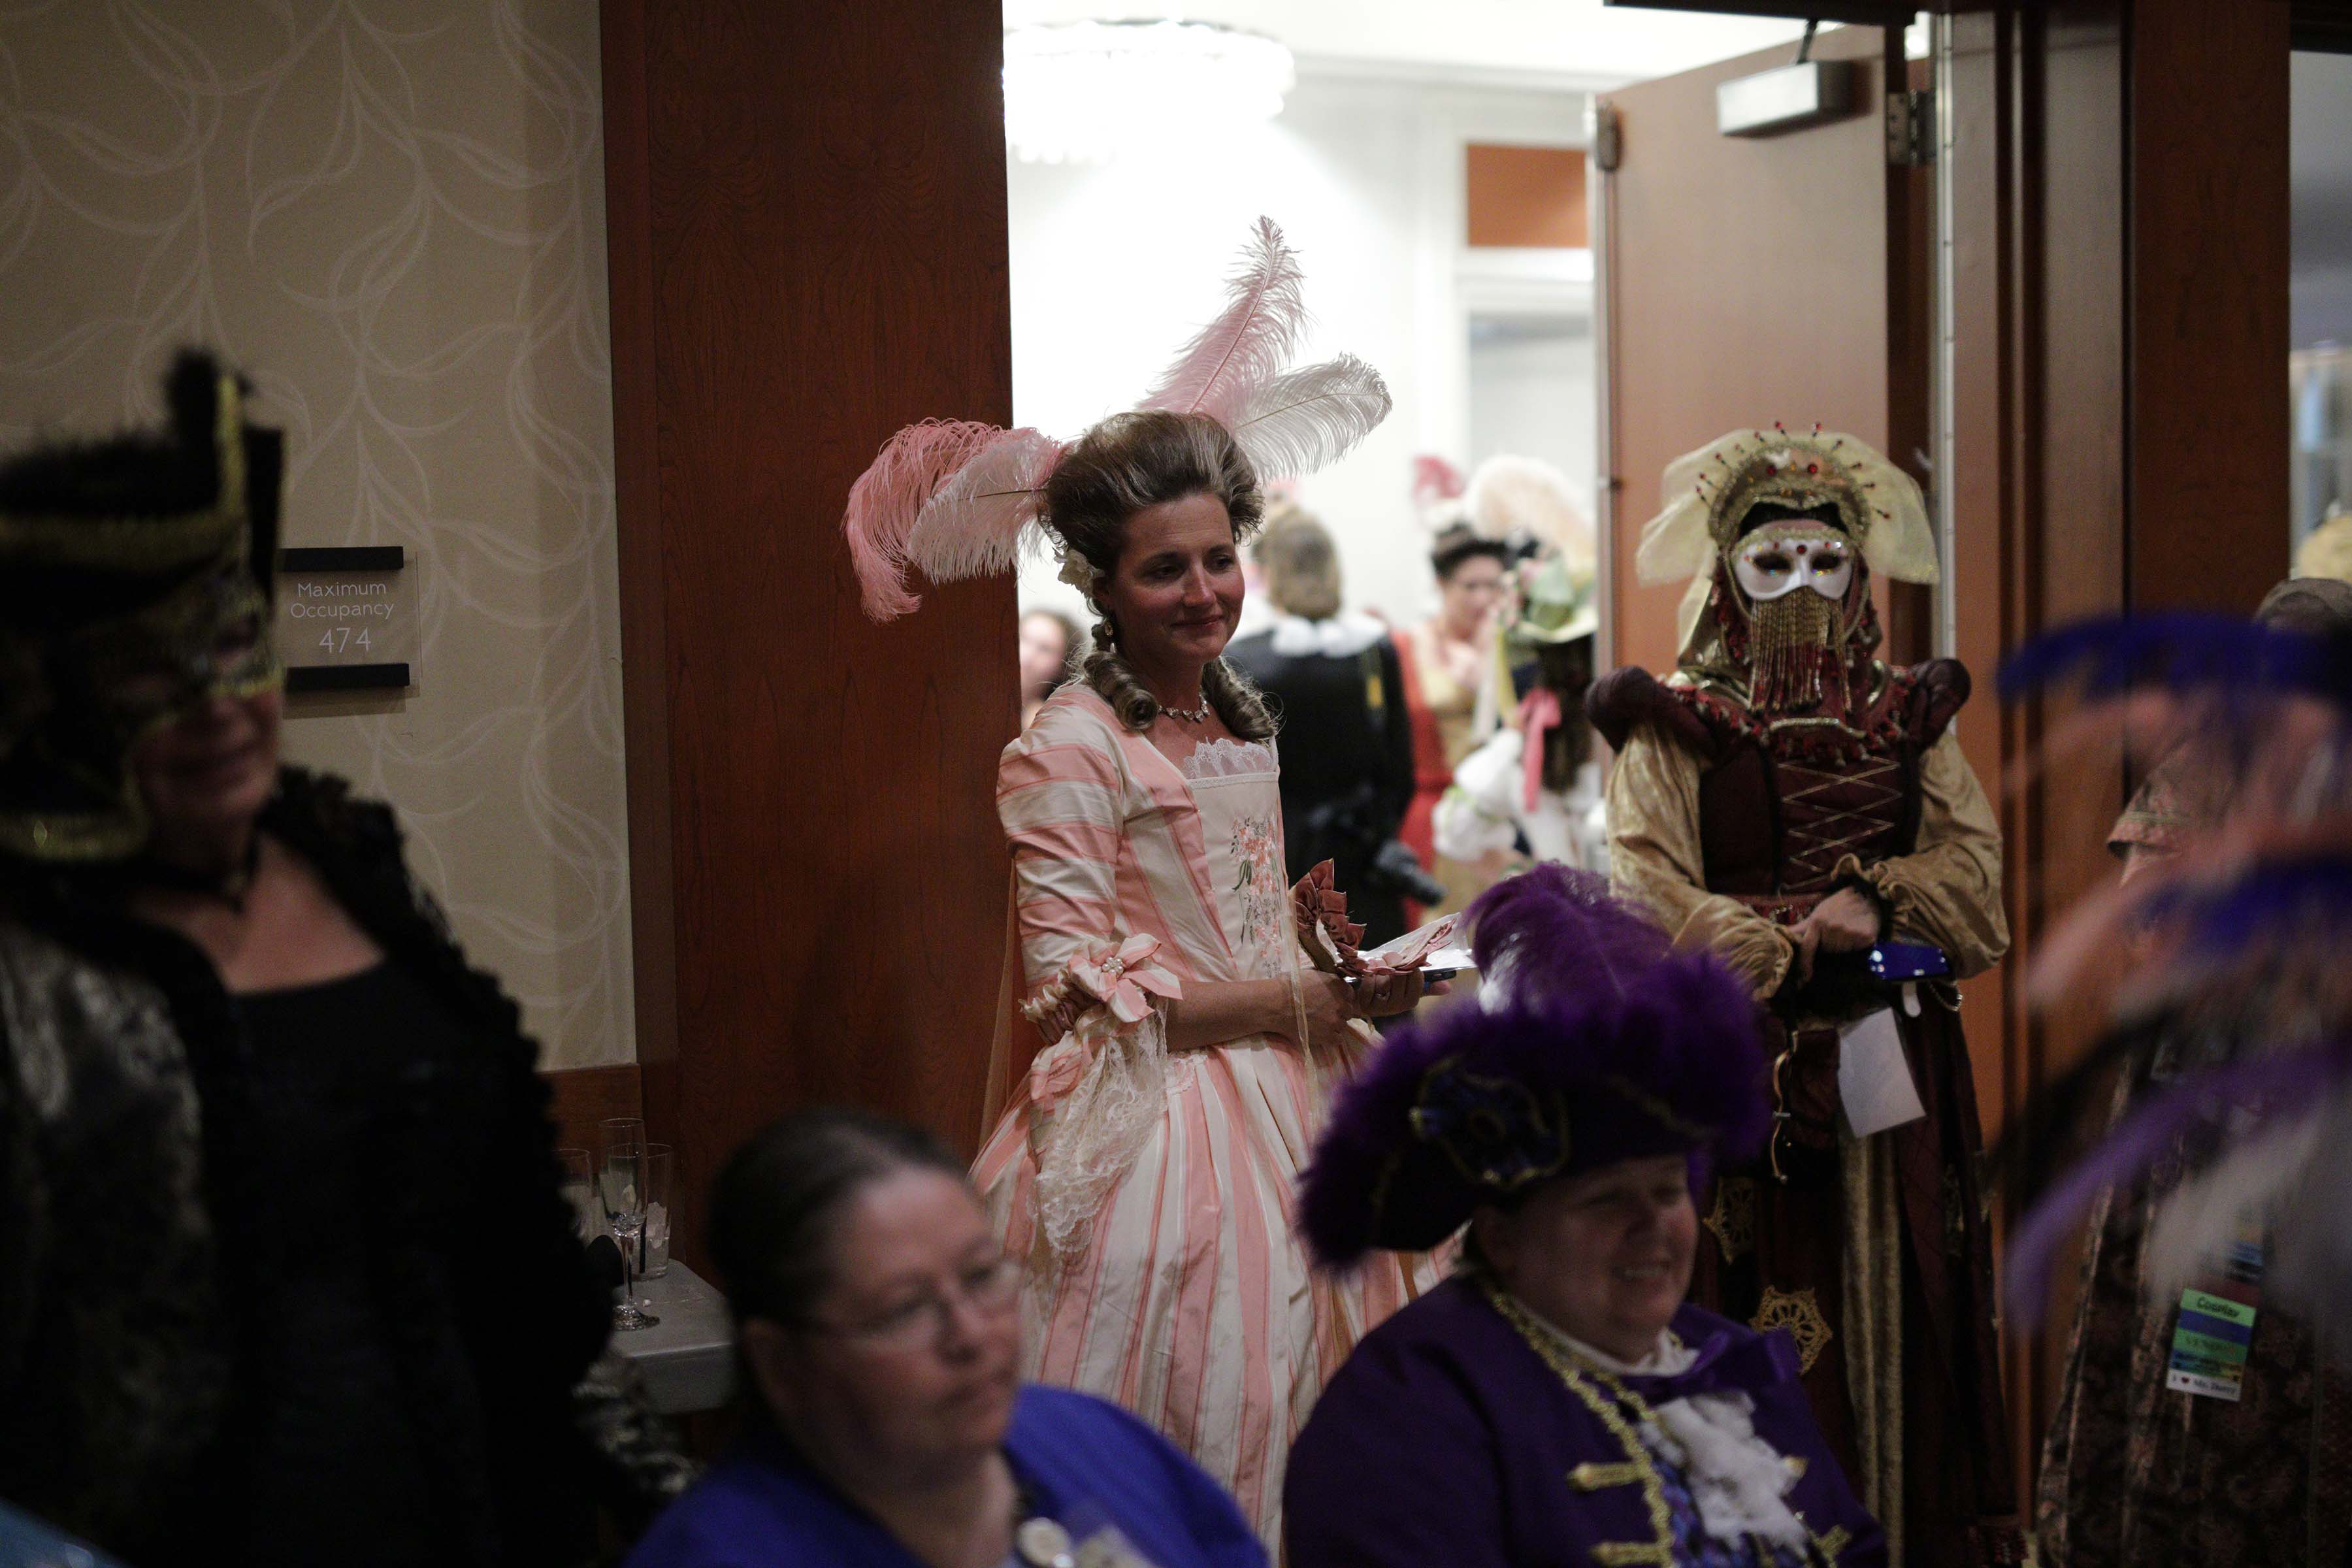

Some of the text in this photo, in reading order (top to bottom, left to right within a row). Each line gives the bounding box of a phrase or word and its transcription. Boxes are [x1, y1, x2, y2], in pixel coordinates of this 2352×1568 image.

[297, 582, 387, 597] Maximum
[290, 602, 395, 621] Occupancy
[319, 627, 371, 653] 474
